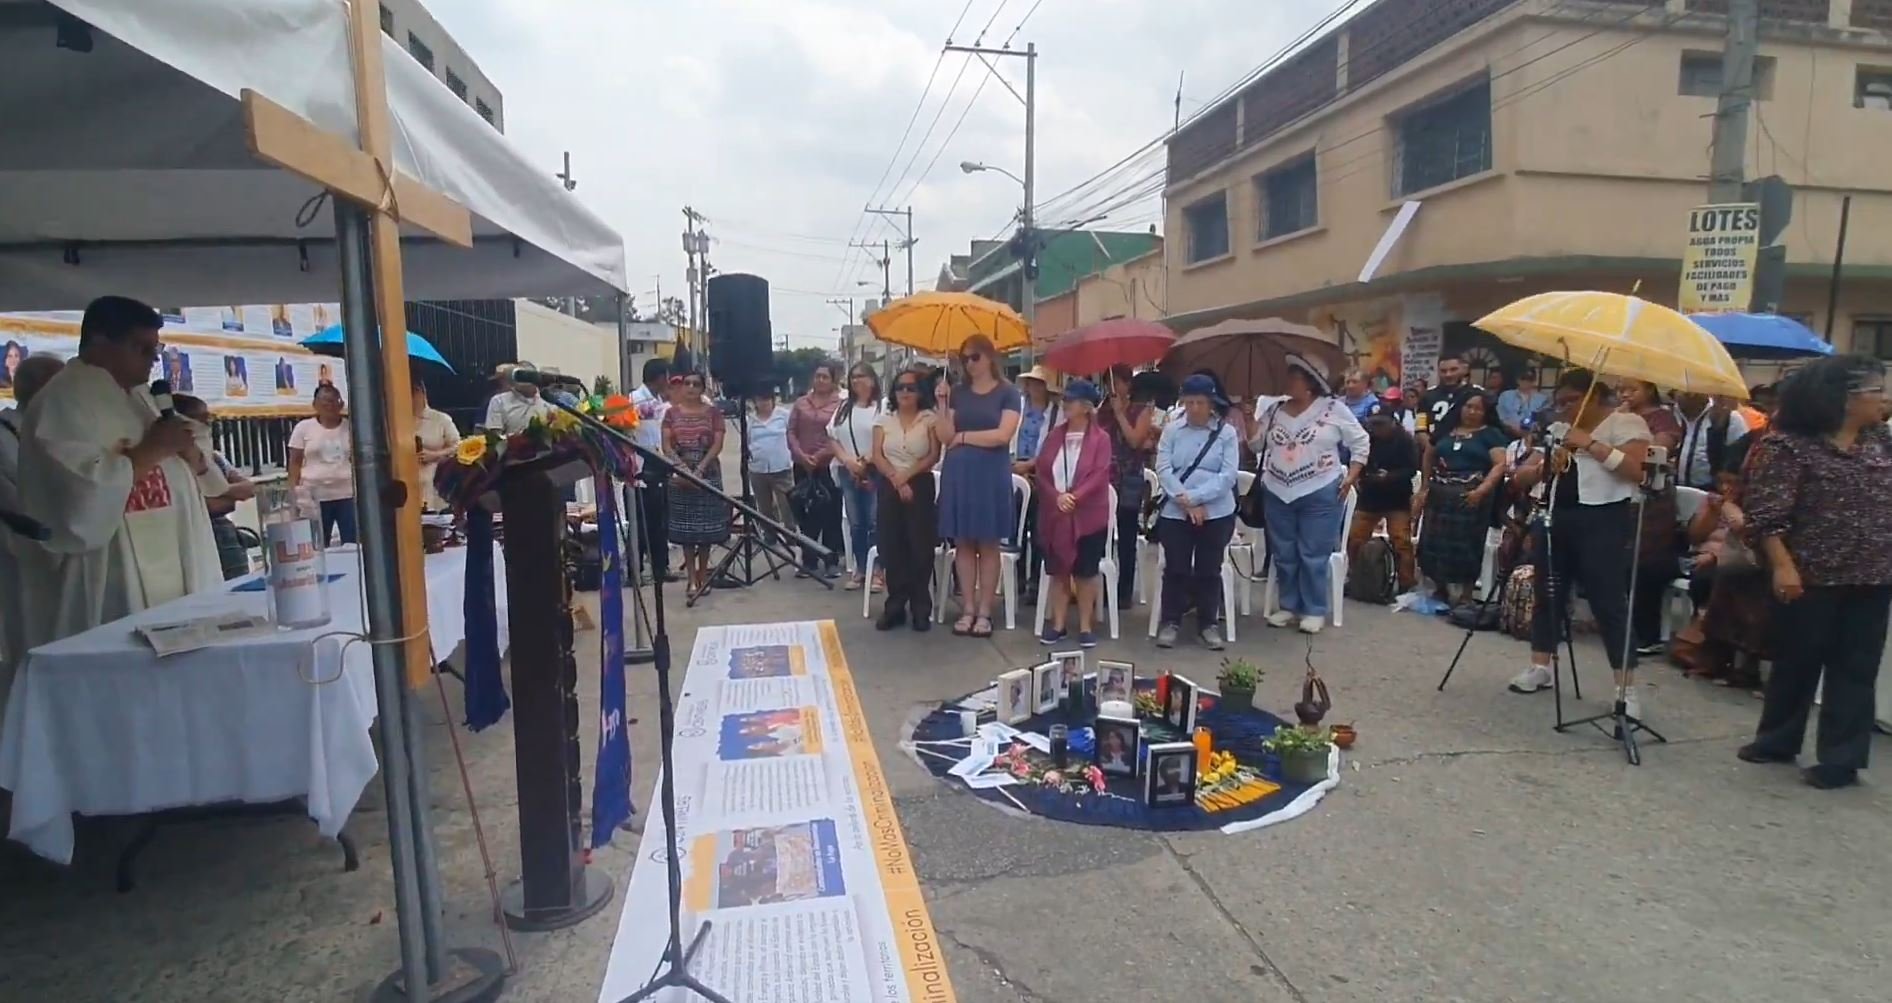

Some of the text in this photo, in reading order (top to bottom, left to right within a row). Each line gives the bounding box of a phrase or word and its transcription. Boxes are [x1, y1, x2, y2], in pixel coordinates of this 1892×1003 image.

[1689, 209, 1759, 232] LOTES
[1689, 235, 1755, 247] AGUA PROPIA
[1704, 247, 1737, 257] TODOS
[1693, 259, 1745, 269] SERVICIOS
[1685, 270, 1748, 280] FACILIDADES
[1696, 281, 1737, 291] DE PAGO
[1701, 294, 1706, 302] Y
[902, 908, 948, 1003] inalización
